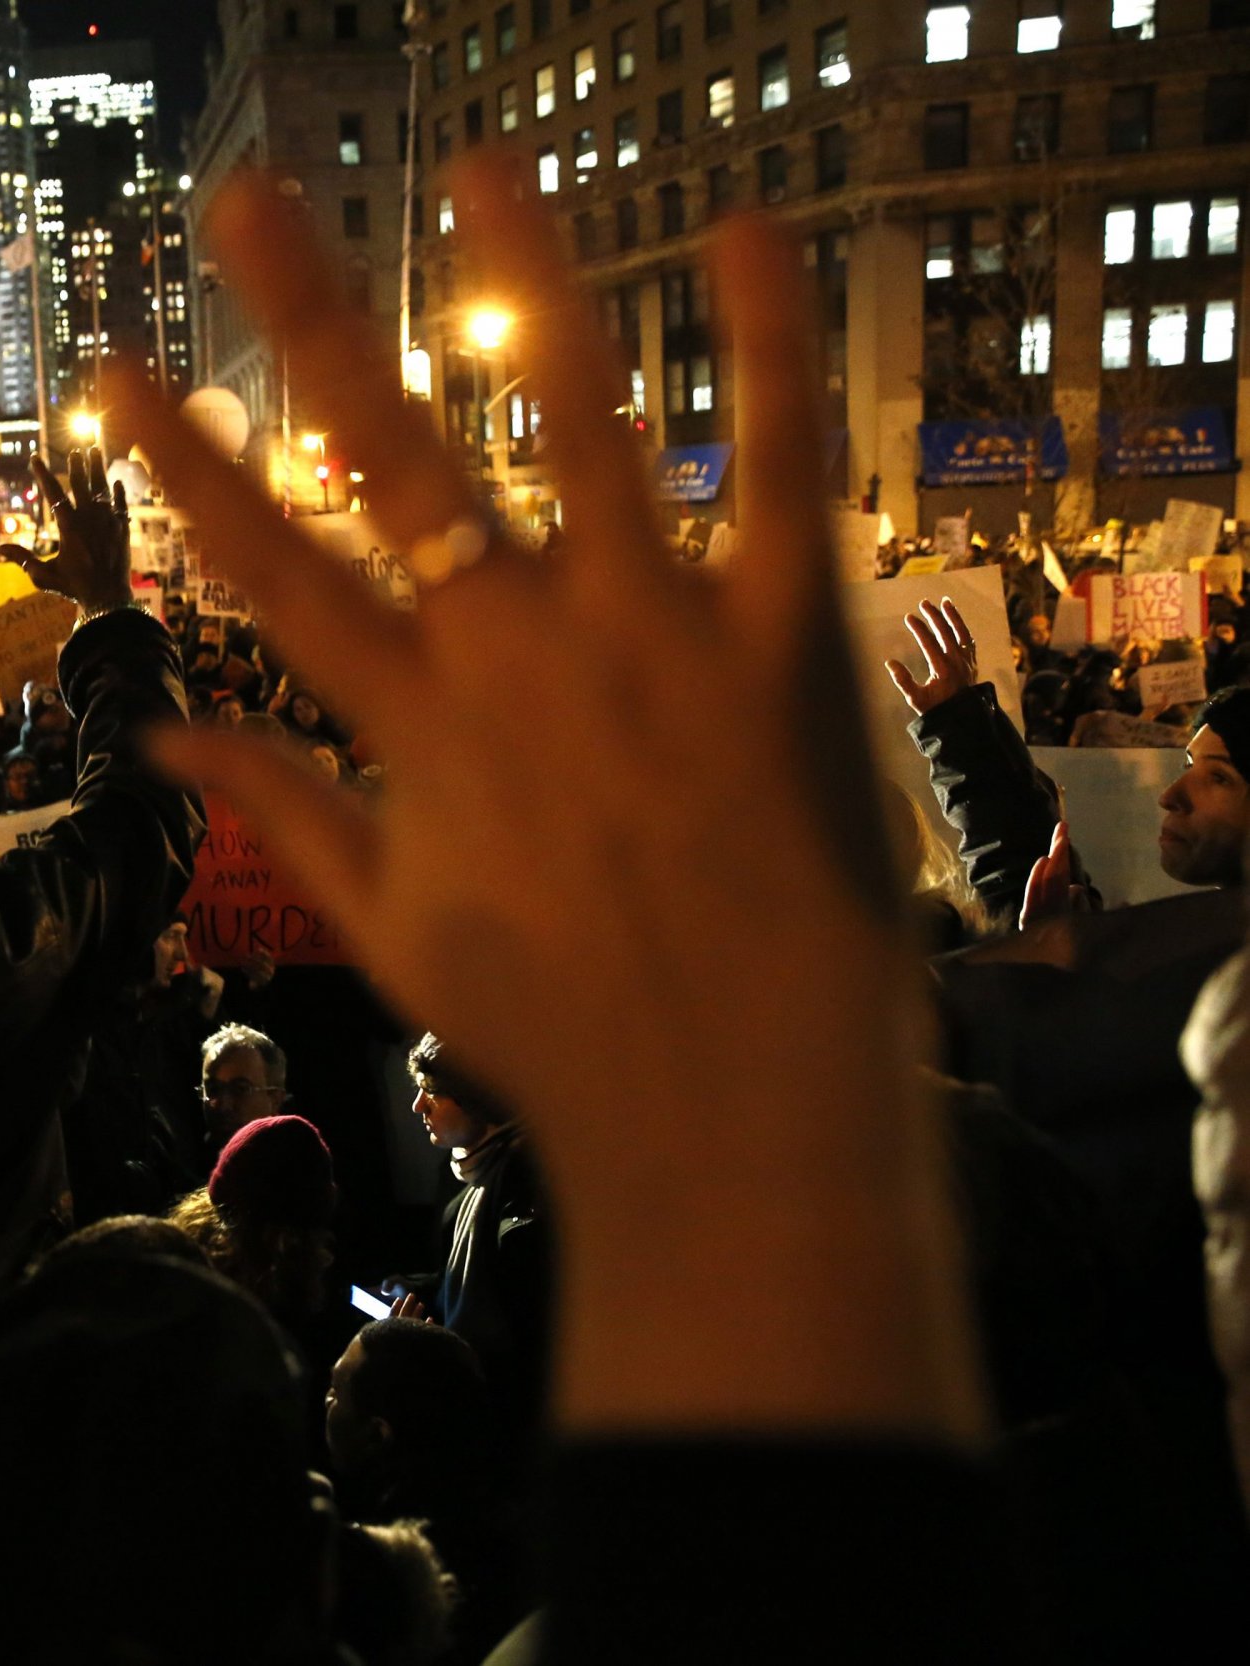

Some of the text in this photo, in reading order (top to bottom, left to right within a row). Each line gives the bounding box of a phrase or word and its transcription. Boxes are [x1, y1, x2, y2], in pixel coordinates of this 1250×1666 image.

[1113, 576, 1180, 598] BLACK
[1113, 598, 1182, 621] LIVES
[1112, 617, 1184, 637] MATTER
[213, 868, 271, 893] AWAY
